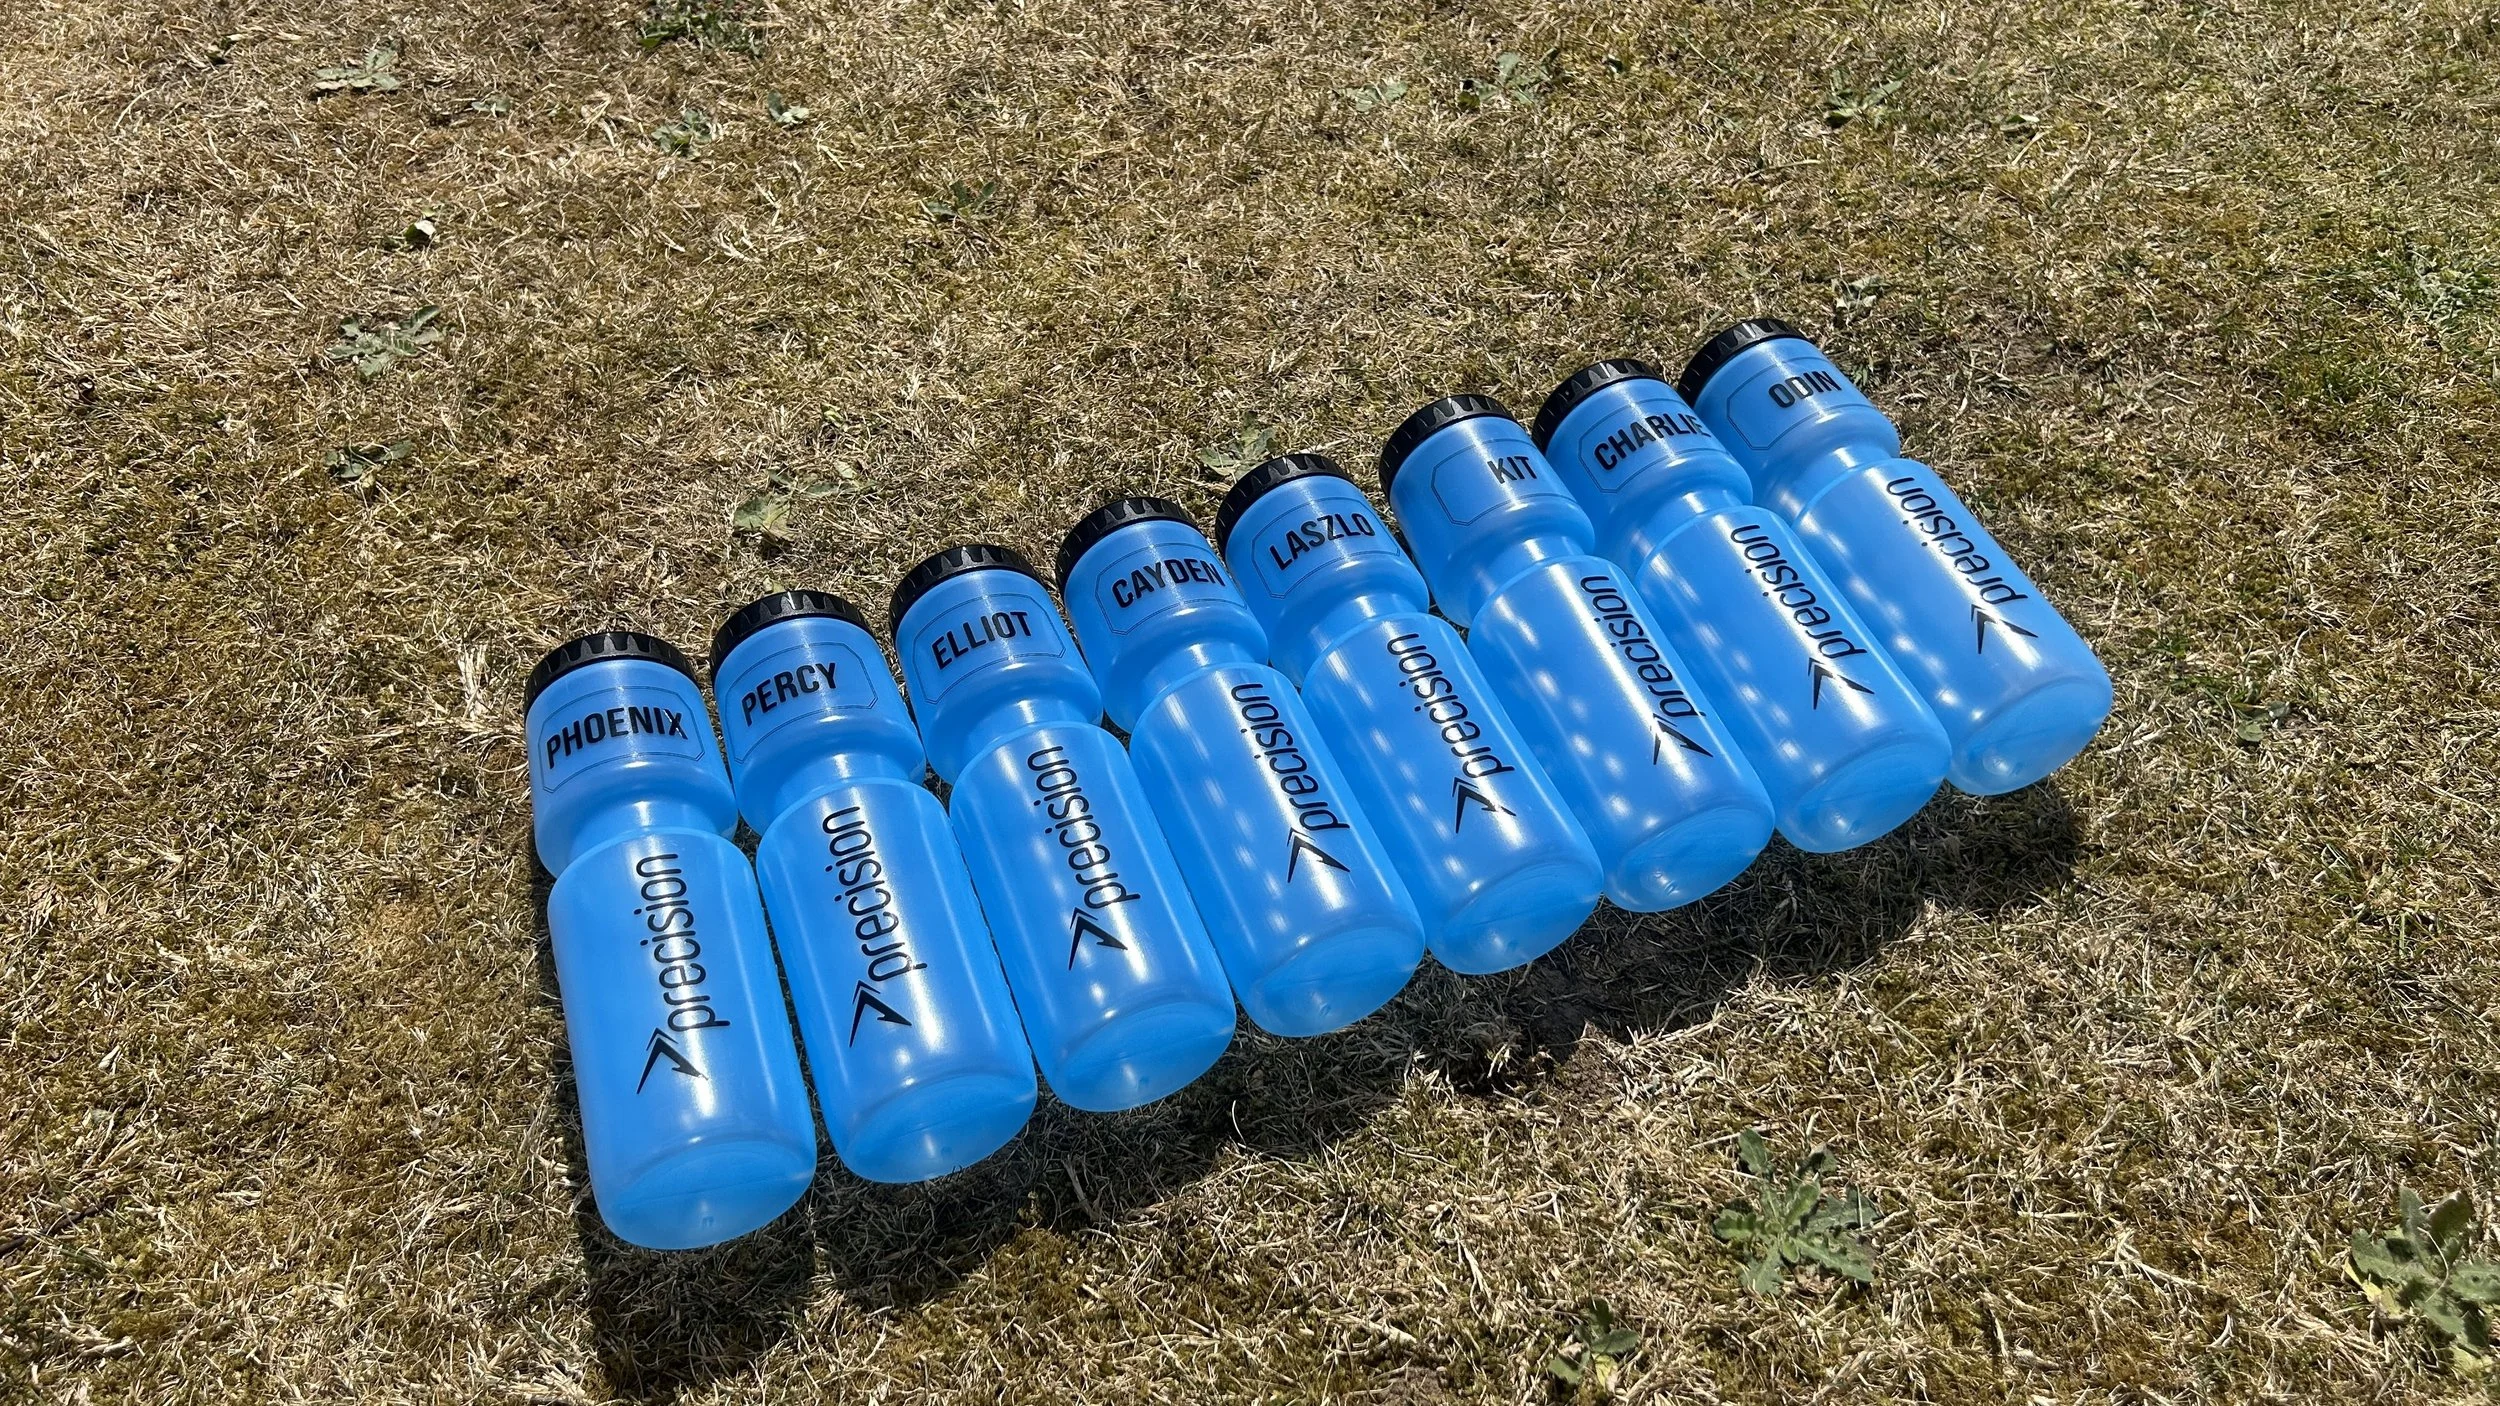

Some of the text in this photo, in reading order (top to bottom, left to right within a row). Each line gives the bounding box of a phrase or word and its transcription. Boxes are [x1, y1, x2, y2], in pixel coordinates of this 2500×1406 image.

[1768, 370, 1842, 408] ODIN
[1487, 455, 1539, 486] KIT
[1594, 413, 1713, 471] CHARLIE
[1112, 558, 1226, 608] CAYDEN
[1269, 513, 1376, 570] LASZLO
[1886, 476, 2029, 606] precision
[1730, 524, 1868, 660] precision
[931, 611, 1033, 670] ELLIOT
[1580, 575, 1707, 718] precision
[546, 706, 688, 768] PHOENIX
[740, 663, 838, 726] PERCY
[1386, 633, 1515, 777] precision
[1230, 683, 1350, 831] precision
[1026, 745, 1141, 909] precision
[822, 806, 927, 982] precision
[633, 852, 731, 1033] precision
